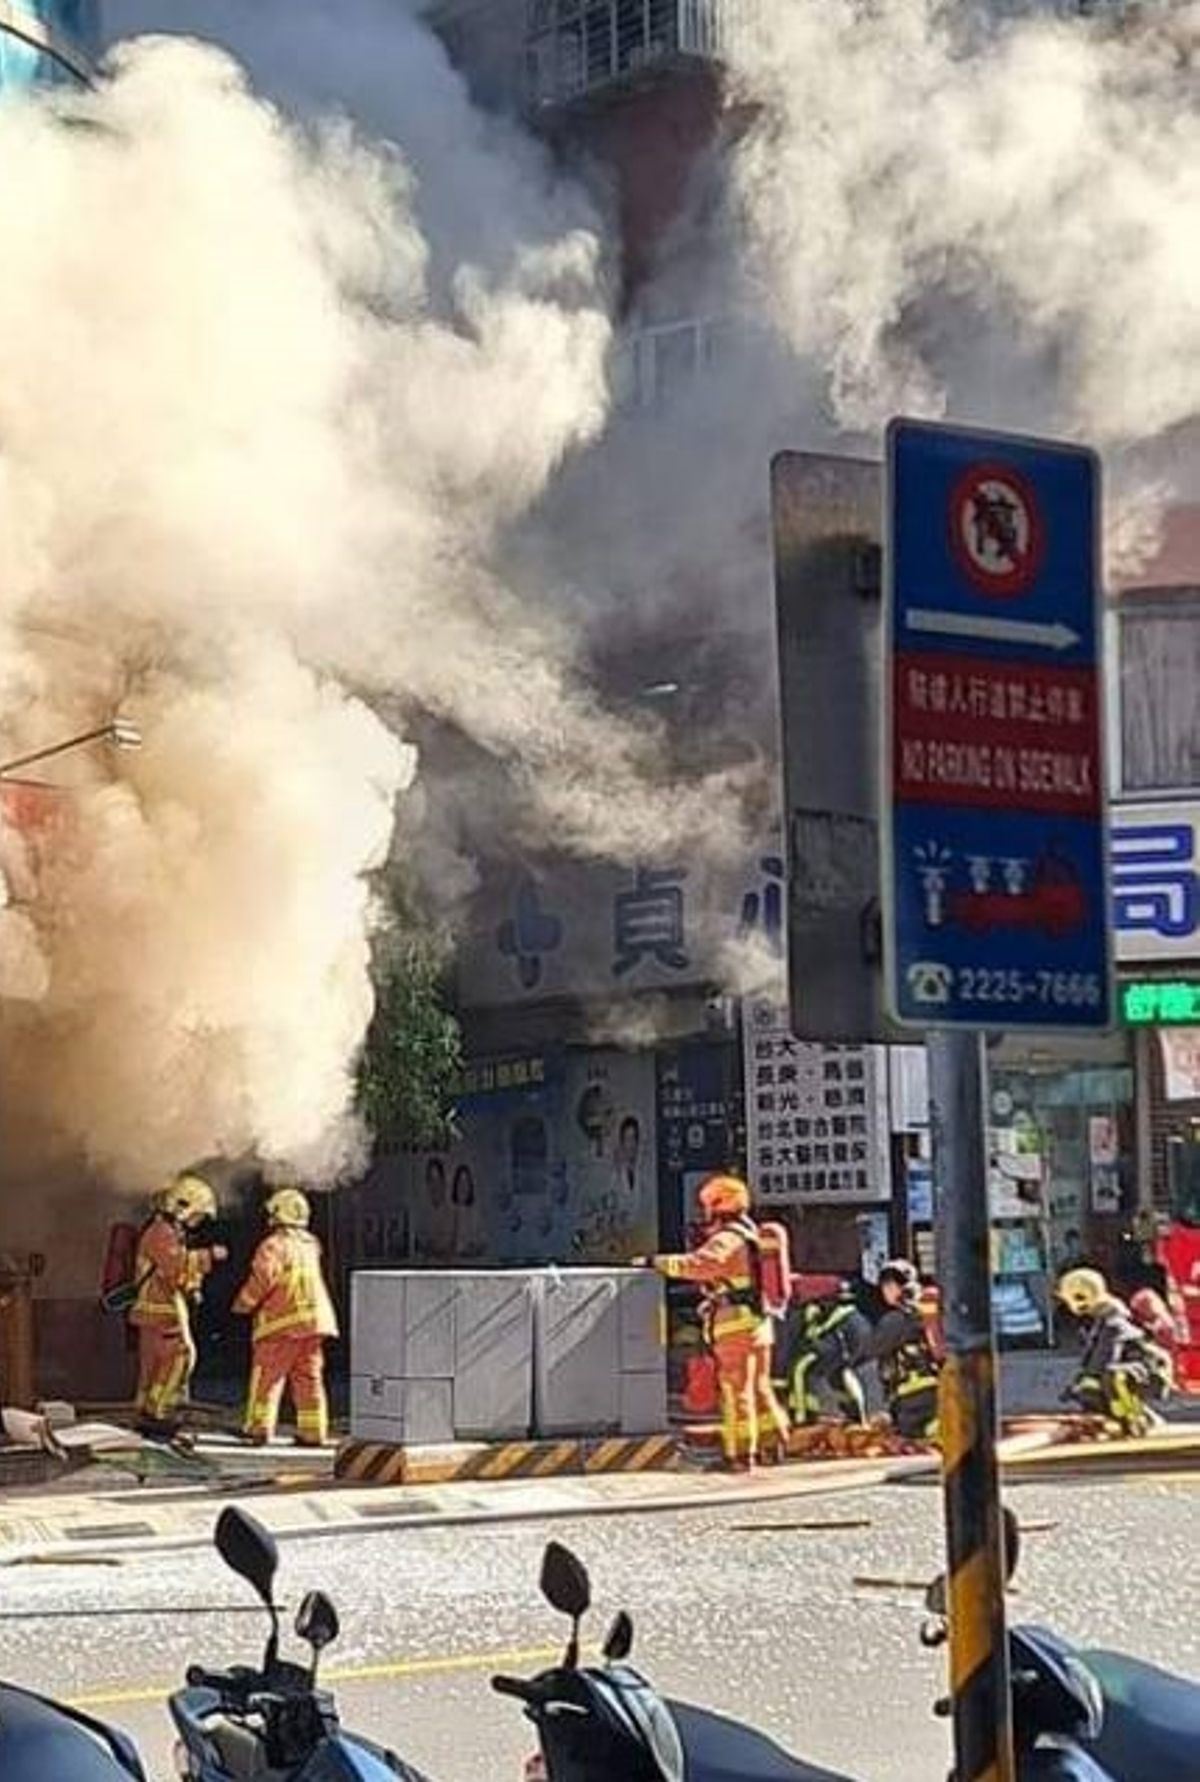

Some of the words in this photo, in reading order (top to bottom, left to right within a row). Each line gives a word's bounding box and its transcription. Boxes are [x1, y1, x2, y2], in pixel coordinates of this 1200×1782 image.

[903, 738, 925, 781] NO
[927, 740, 992, 788] PARKING
[994, 746, 1017, 791] ON
[1019, 748, 1093, 797] SIDEWALK
